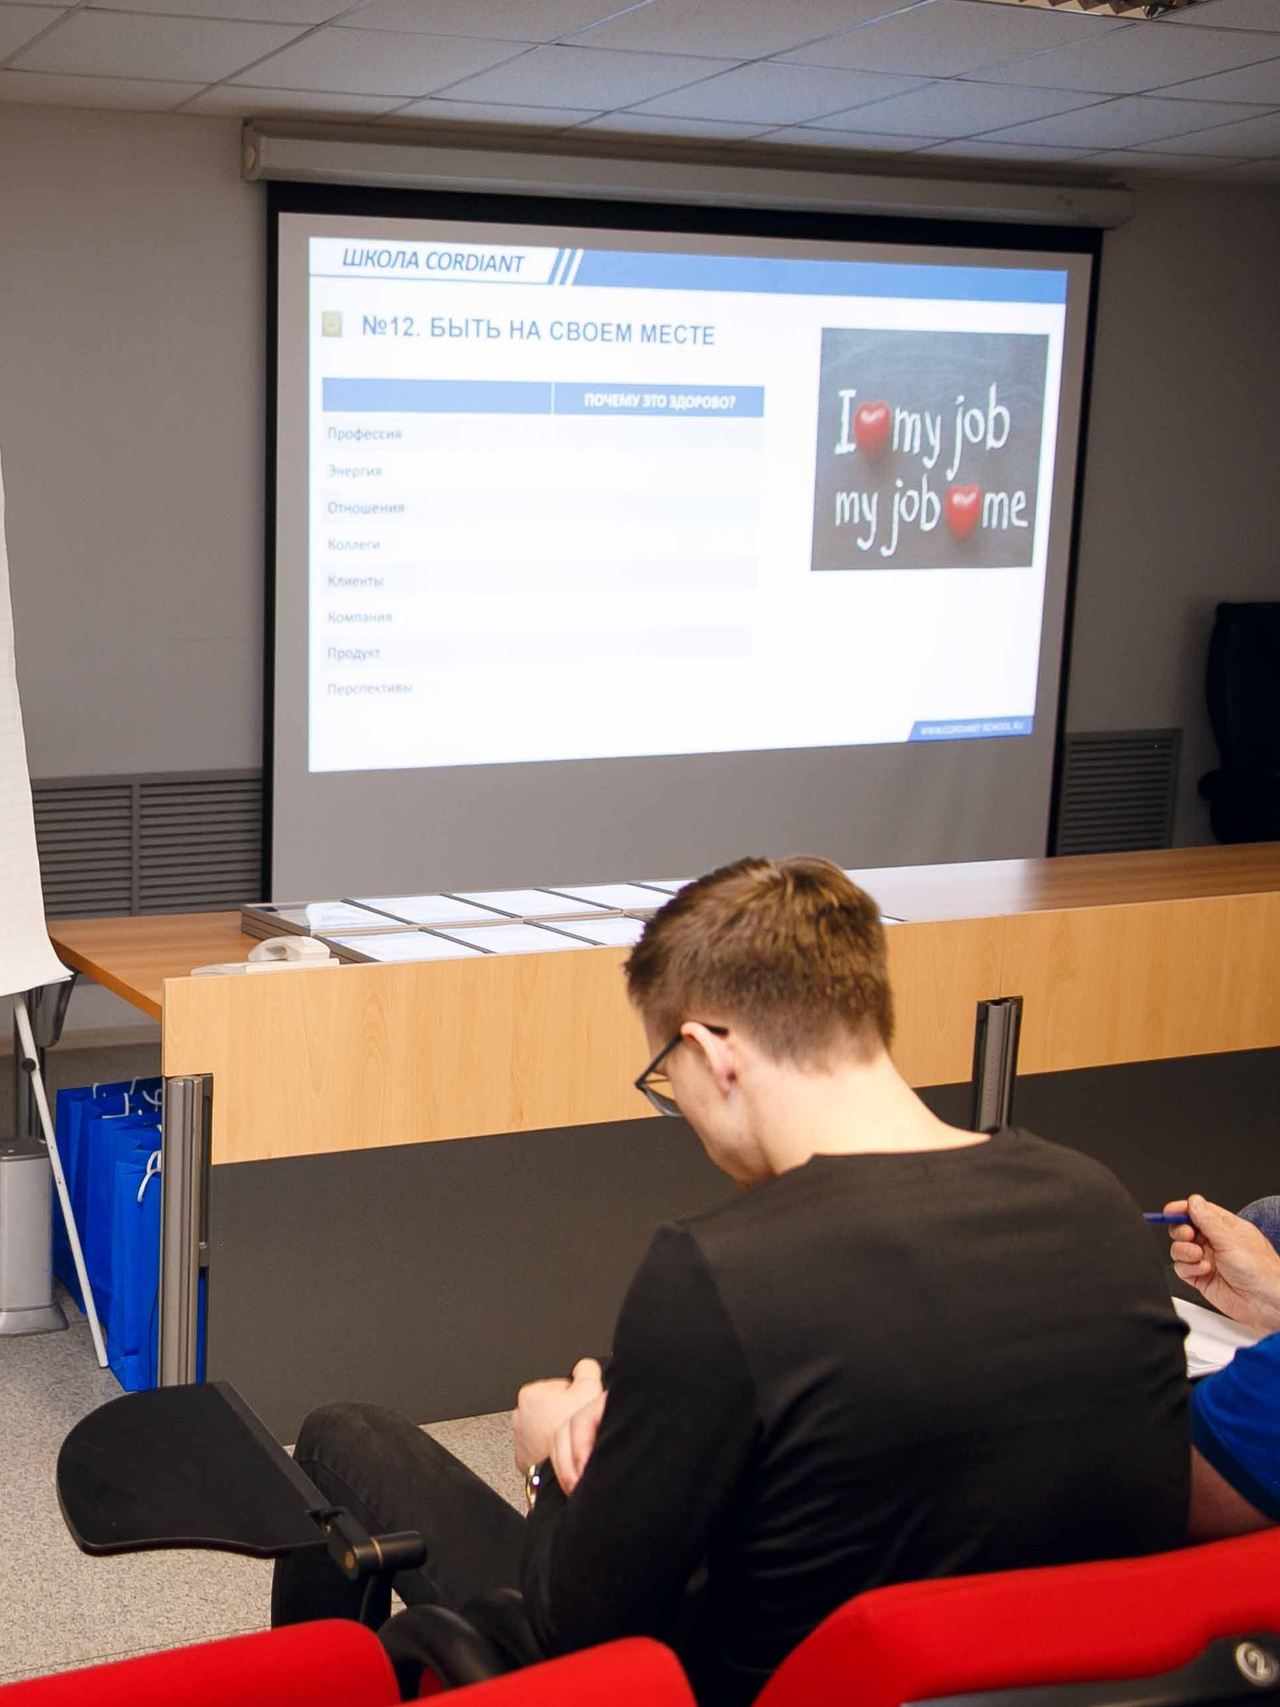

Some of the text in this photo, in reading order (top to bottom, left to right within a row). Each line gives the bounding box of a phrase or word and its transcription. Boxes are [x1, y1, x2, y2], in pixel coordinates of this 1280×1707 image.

[342, 248, 526, 274] ШКОЛА CORDIANT
[362, 314, 716, 346] №12. БЫТЬ НА СВОЕМ МЕСТЕ
[584, 392, 737, 411] ПОЧЕМУ ЭТО ЗДОРОВО?
[327, 426, 402, 442] Профессия
[834, 381, 1012, 482] I my job
[327, 464, 383, 479] Энергия
[327, 501, 405, 514] Отношения
[835, 472, 1029, 557] my job me
[327, 539, 380, 552] Коллеги
[327, 575, 384, 588] Клиенты
[327, 612, 393, 625] Компания
[327, 647, 381, 662] Продукт
